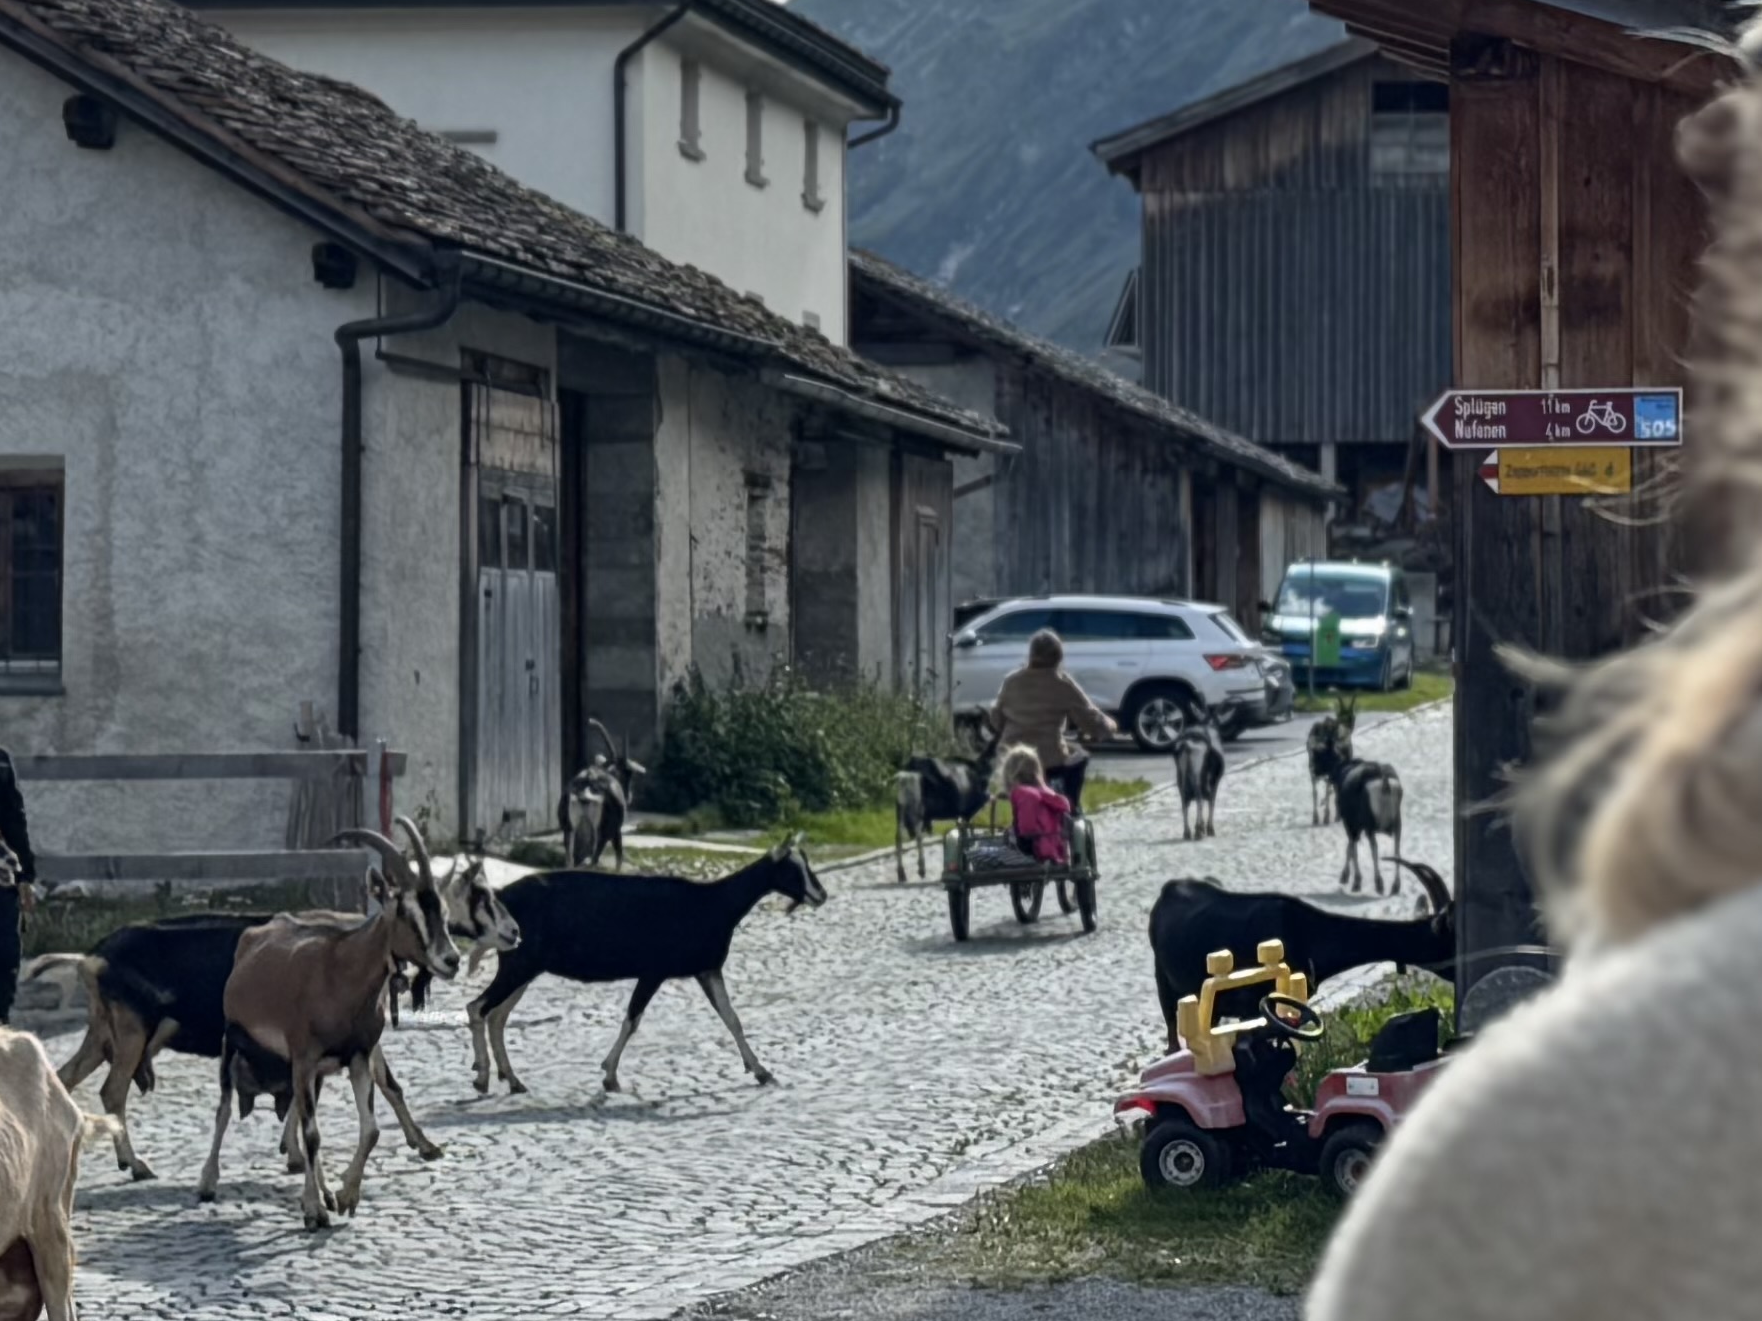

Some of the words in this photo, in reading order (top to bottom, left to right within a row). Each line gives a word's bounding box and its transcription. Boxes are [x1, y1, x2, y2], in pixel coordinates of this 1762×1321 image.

[1541, 397, 1553, 415] 11
[1554, 398, 1571, 415] km
[1554, 423, 1571, 438] km
